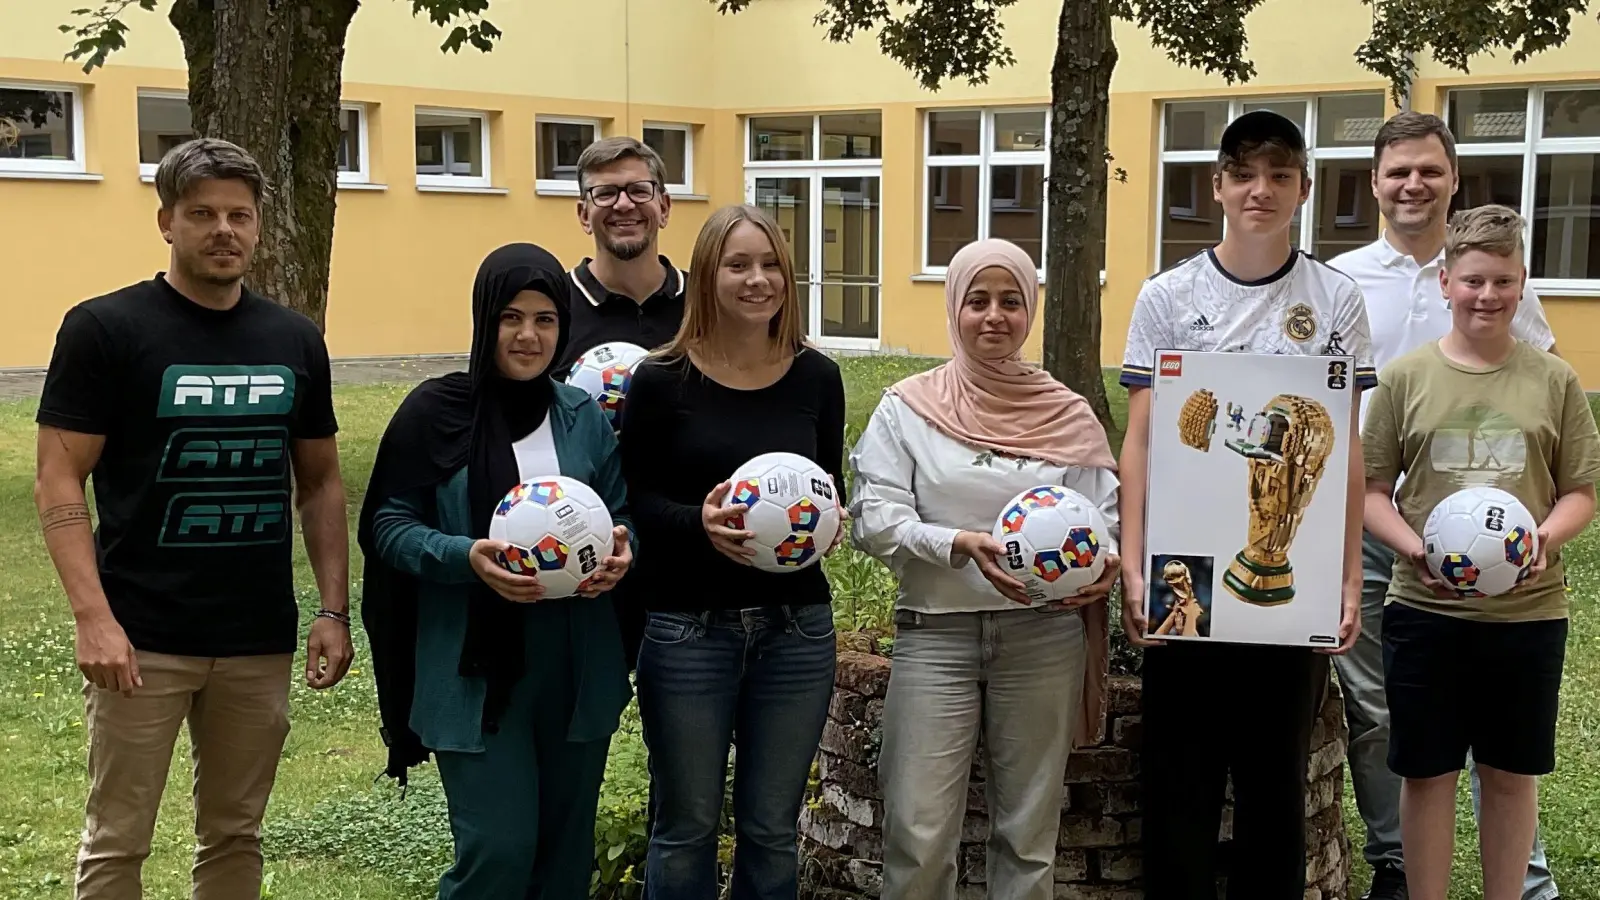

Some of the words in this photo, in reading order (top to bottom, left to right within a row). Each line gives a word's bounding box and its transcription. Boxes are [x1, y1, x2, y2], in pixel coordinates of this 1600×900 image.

[1162, 361, 1180, 369] LEGO
[174, 375, 284, 404] ATP
[177, 439, 282, 468] ATP
[178, 503, 283, 534] ATP
